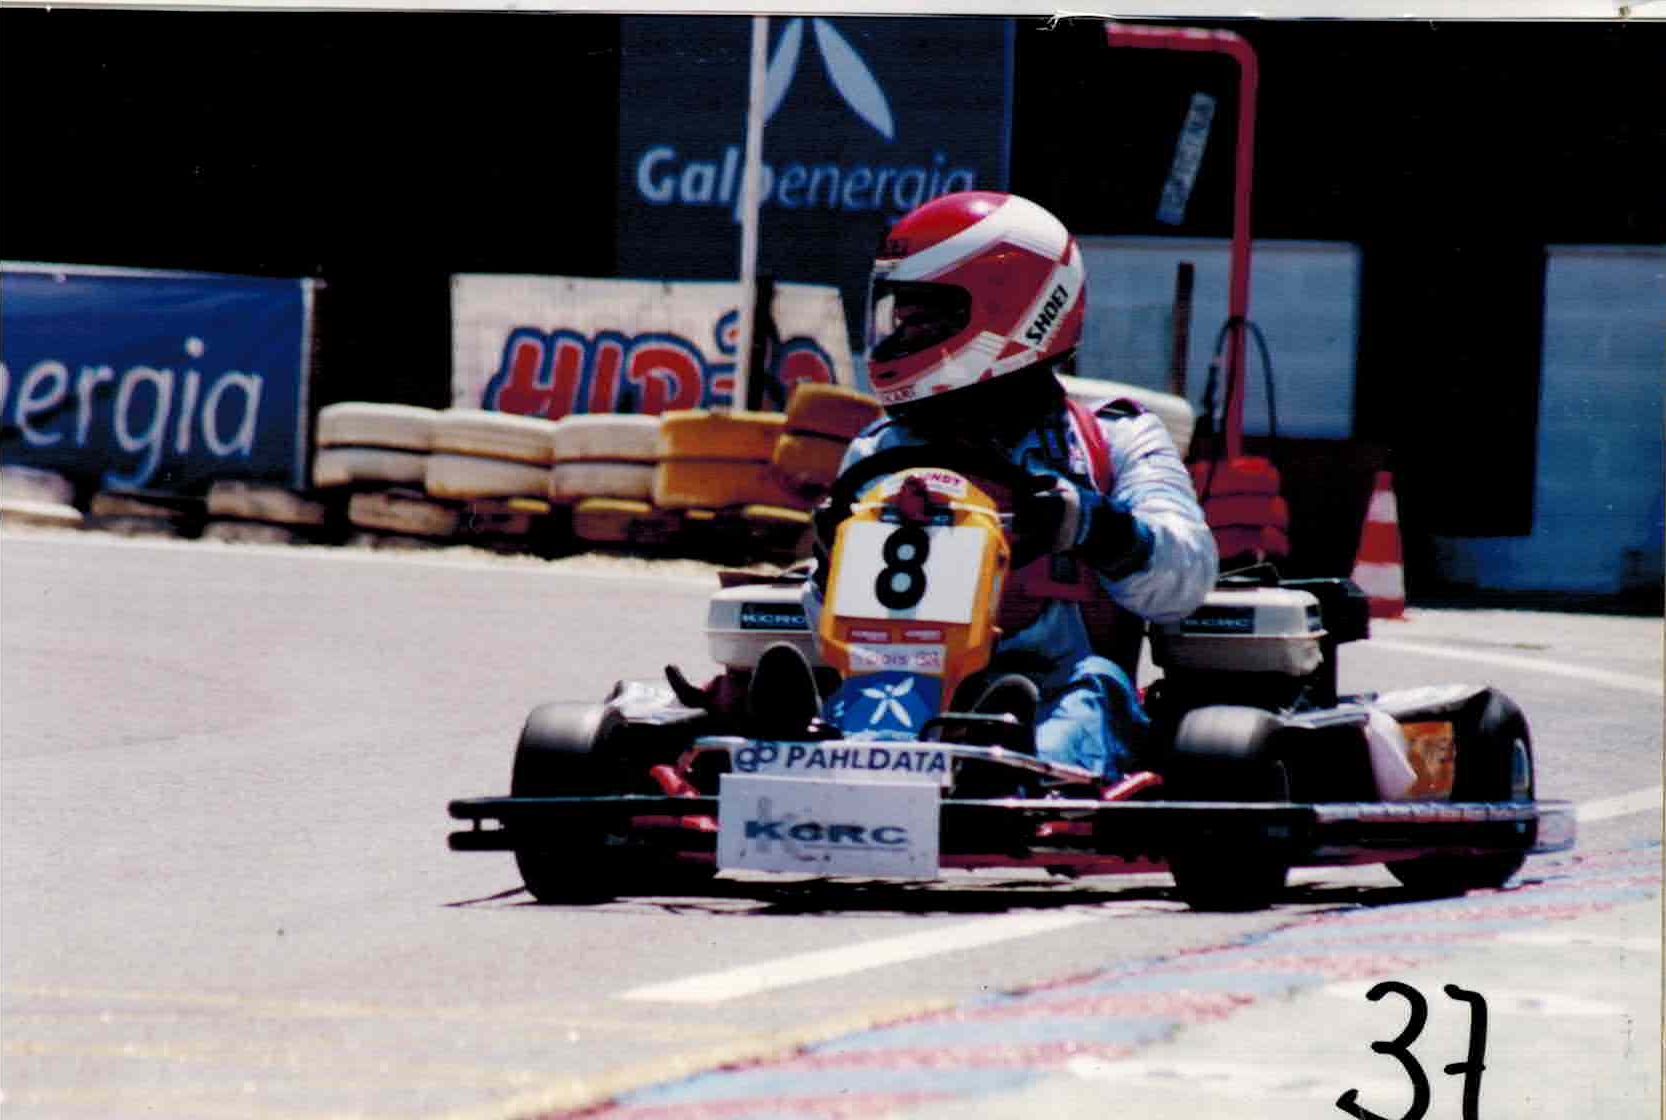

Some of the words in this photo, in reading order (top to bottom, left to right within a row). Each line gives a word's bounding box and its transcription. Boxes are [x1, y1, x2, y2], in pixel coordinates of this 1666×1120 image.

[1025, 283, 1069, 345] SHOEI
[875, 526, 930, 610] 8
[786, 746, 947, 773] PAHLDATA
[743, 819, 909, 846] KCRC
